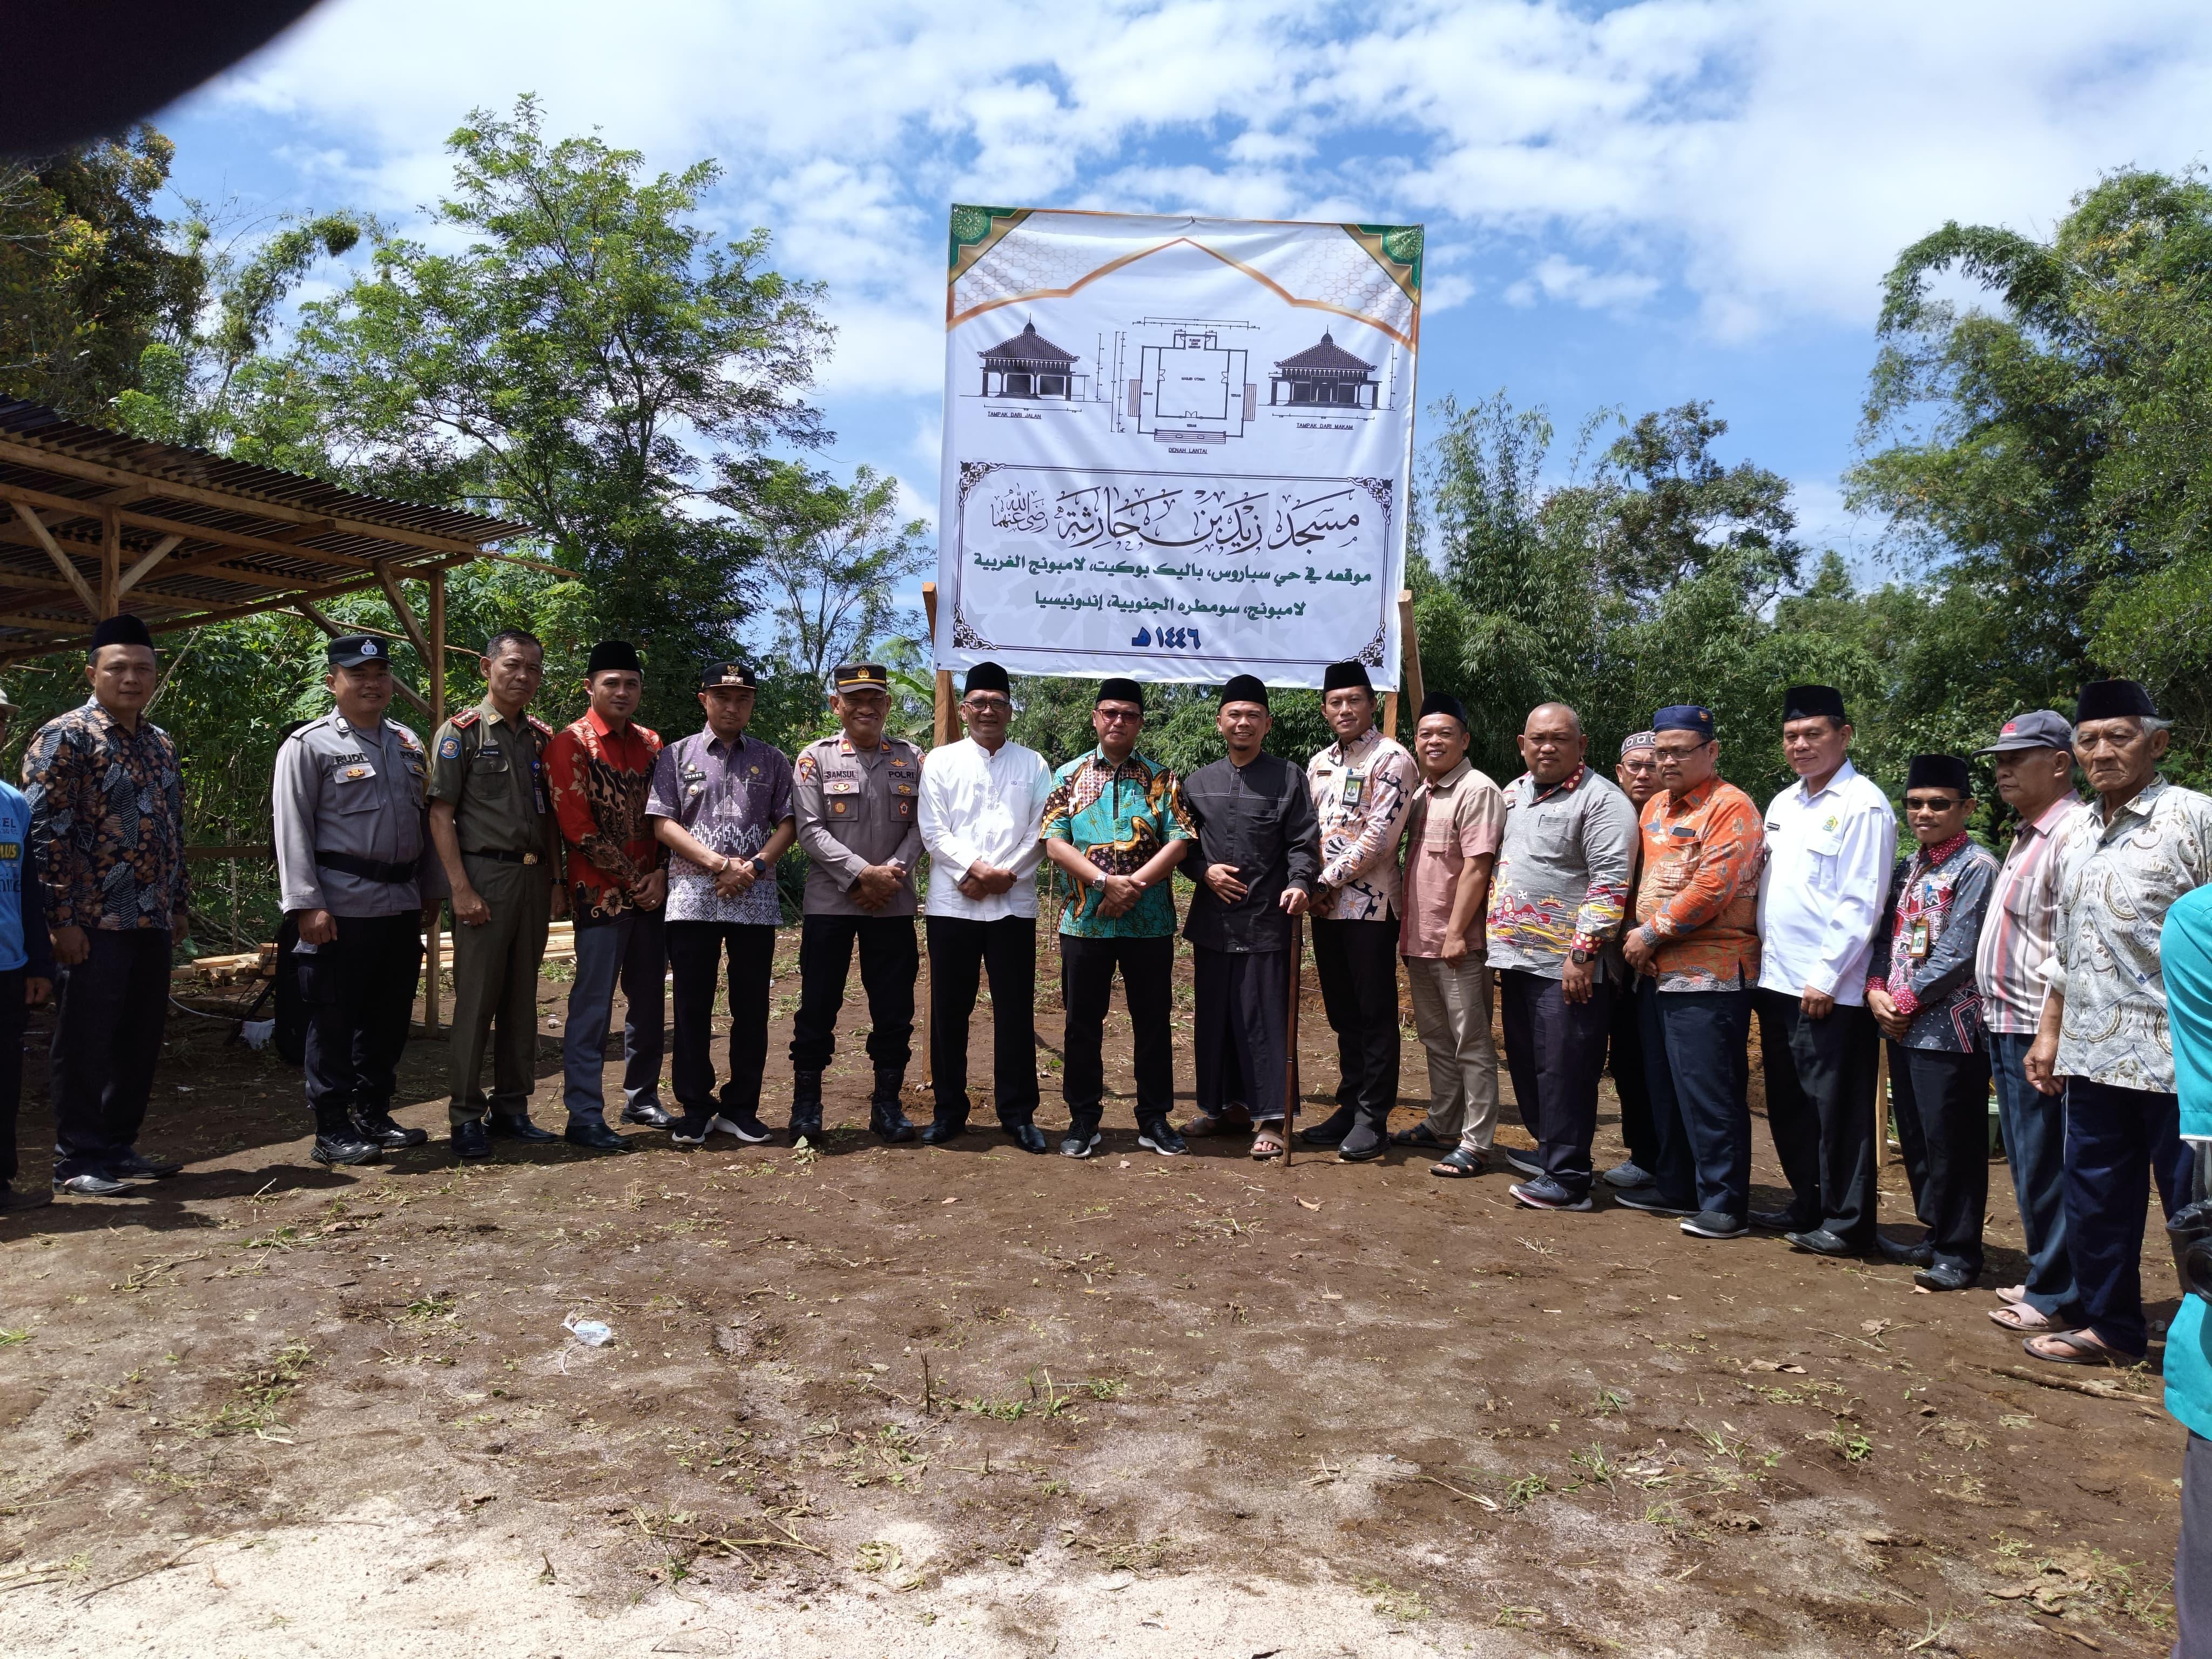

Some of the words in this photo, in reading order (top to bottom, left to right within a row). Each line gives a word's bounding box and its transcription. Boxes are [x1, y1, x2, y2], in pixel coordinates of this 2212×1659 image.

[973, 552, 1026, 571] الغربية
[1028, 556, 1087, 575] لامبونج
[1273, 569, 1301, 587] حي
[1304, 566, 1322, 584] في
[1325, 568, 1372, 586] موقعه
[1035, 590, 1103, 611] إندونيسيا
[1177, 598, 1240, 617] سومطره
[1243, 601, 1306, 621] لامبونج،
[1158, 625, 1202, 650] ١٤٤٦
[336, 752, 365, 765] RUDI
[826, 771, 856, 779] SAMSUL
[889, 771, 914, 779] POLRI
[0, 817, 16, 828] EL
